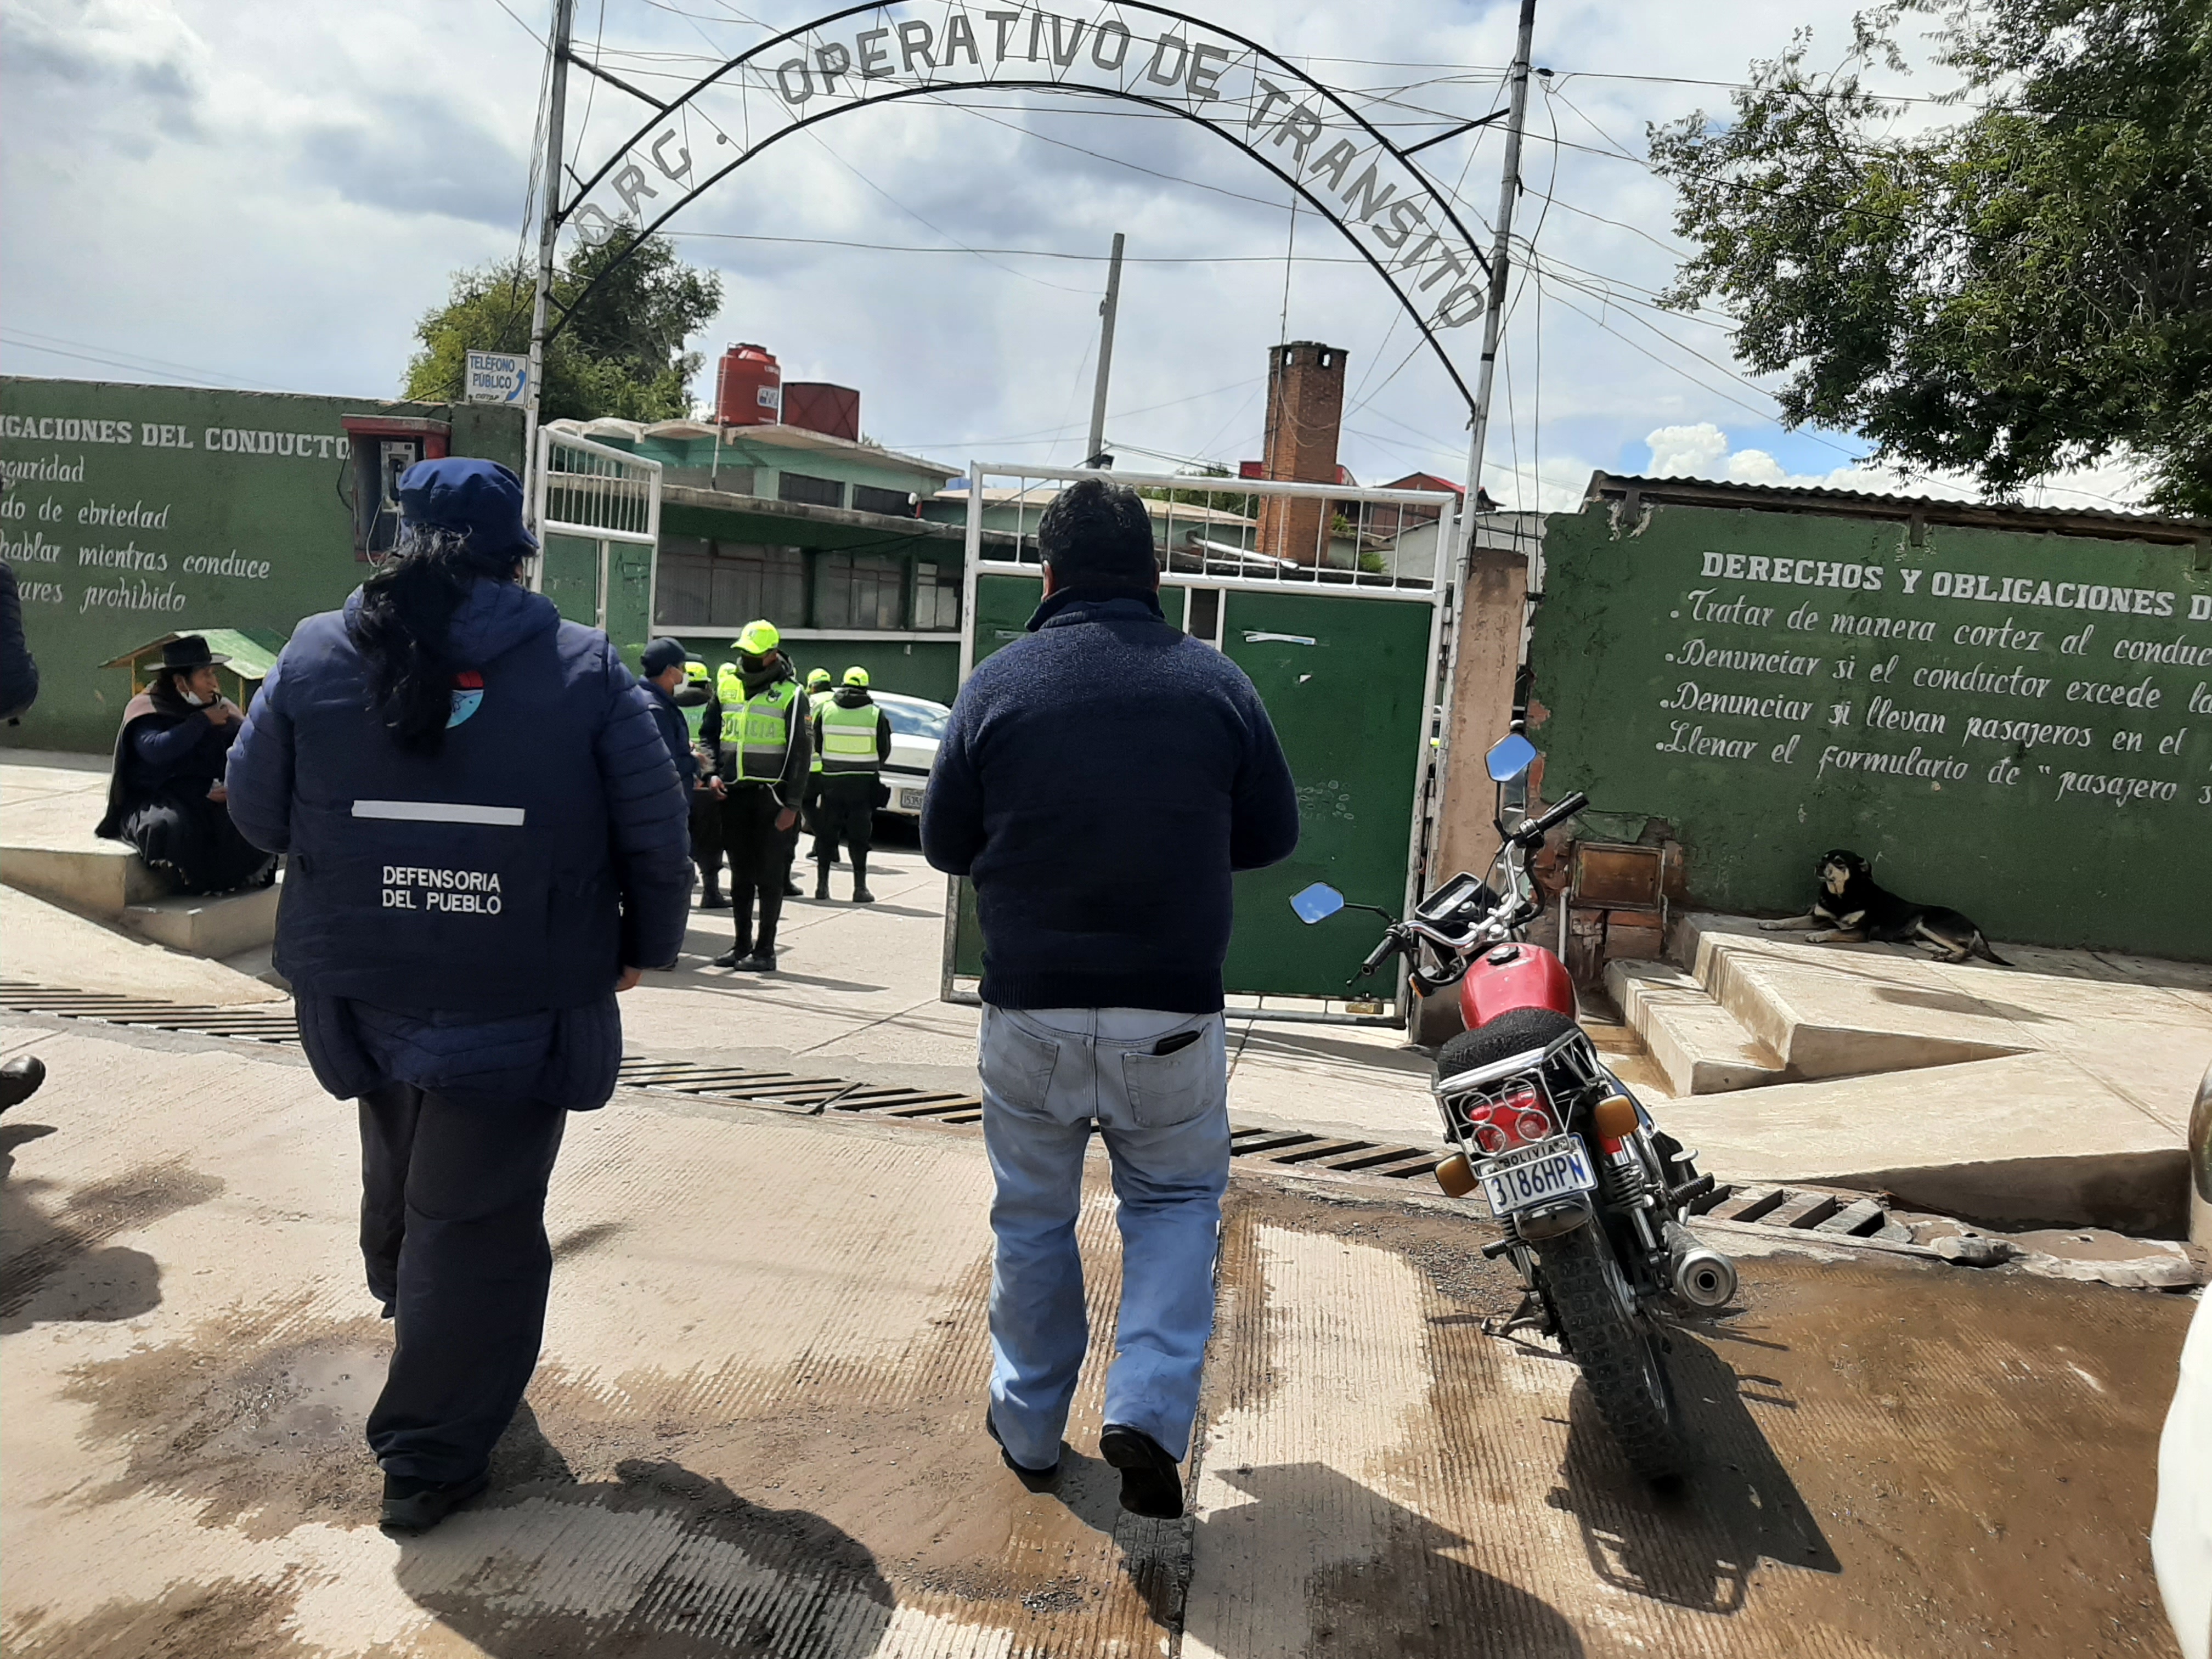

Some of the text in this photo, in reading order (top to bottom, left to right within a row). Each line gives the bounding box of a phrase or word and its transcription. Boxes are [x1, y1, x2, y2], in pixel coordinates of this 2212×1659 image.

[776, 10, 1130, 105] OPERATIVO
[1147, 31, 1229, 100] DE
[1248, 77, 1485, 328] TRANSITO
[141, 422, 194, 449] DEL
[205, 427, 351, 460] CONDUCTO
[38, 495, 63, 522] de
[77, 500, 171, 529] ebriedad
[0, 528, 270, 580] hablar mientras conduce
[17, 577, 186, 614] ares prohibido
[1701, 551, 1883, 590] DERECHOS
[1900, 569, 1922, 594] Y
[1931, 571, 2175, 617] OBLIGACIONES
[1688, 588, 1774, 627] Tratar
[1787, 601, 1819, 631] de
[1830, 613, 1936, 642] manera
[1954, 617, 2045, 651] cortez
[2060, 624, 2094, 655] al
[1677, 638, 1821, 676] Denunciar
[1832, 655, 1855, 680] si
[1870, 654, 1899, 683] el
[1913, 662, 2052, 698] conductor
[2066, 676, 2161, 709] excede
[1670, 681, 2188, 755] Denunciar si llevan pasajeros en el
[1664, 719, 1758, 760] Llenar
[1770, 734, 1801, 764] el
[1816, 745, 1968, 778] formulario
[1988, 756, 2021, 785] de
[382, 889, 501, 915] DEL PUEBLO
[383, 866, 500, 892] DEFENSORIA
[1491, 1154, 1587, 1206] 3186HPN
[1503, 1144, 1555, 1167] BOLIVIA
